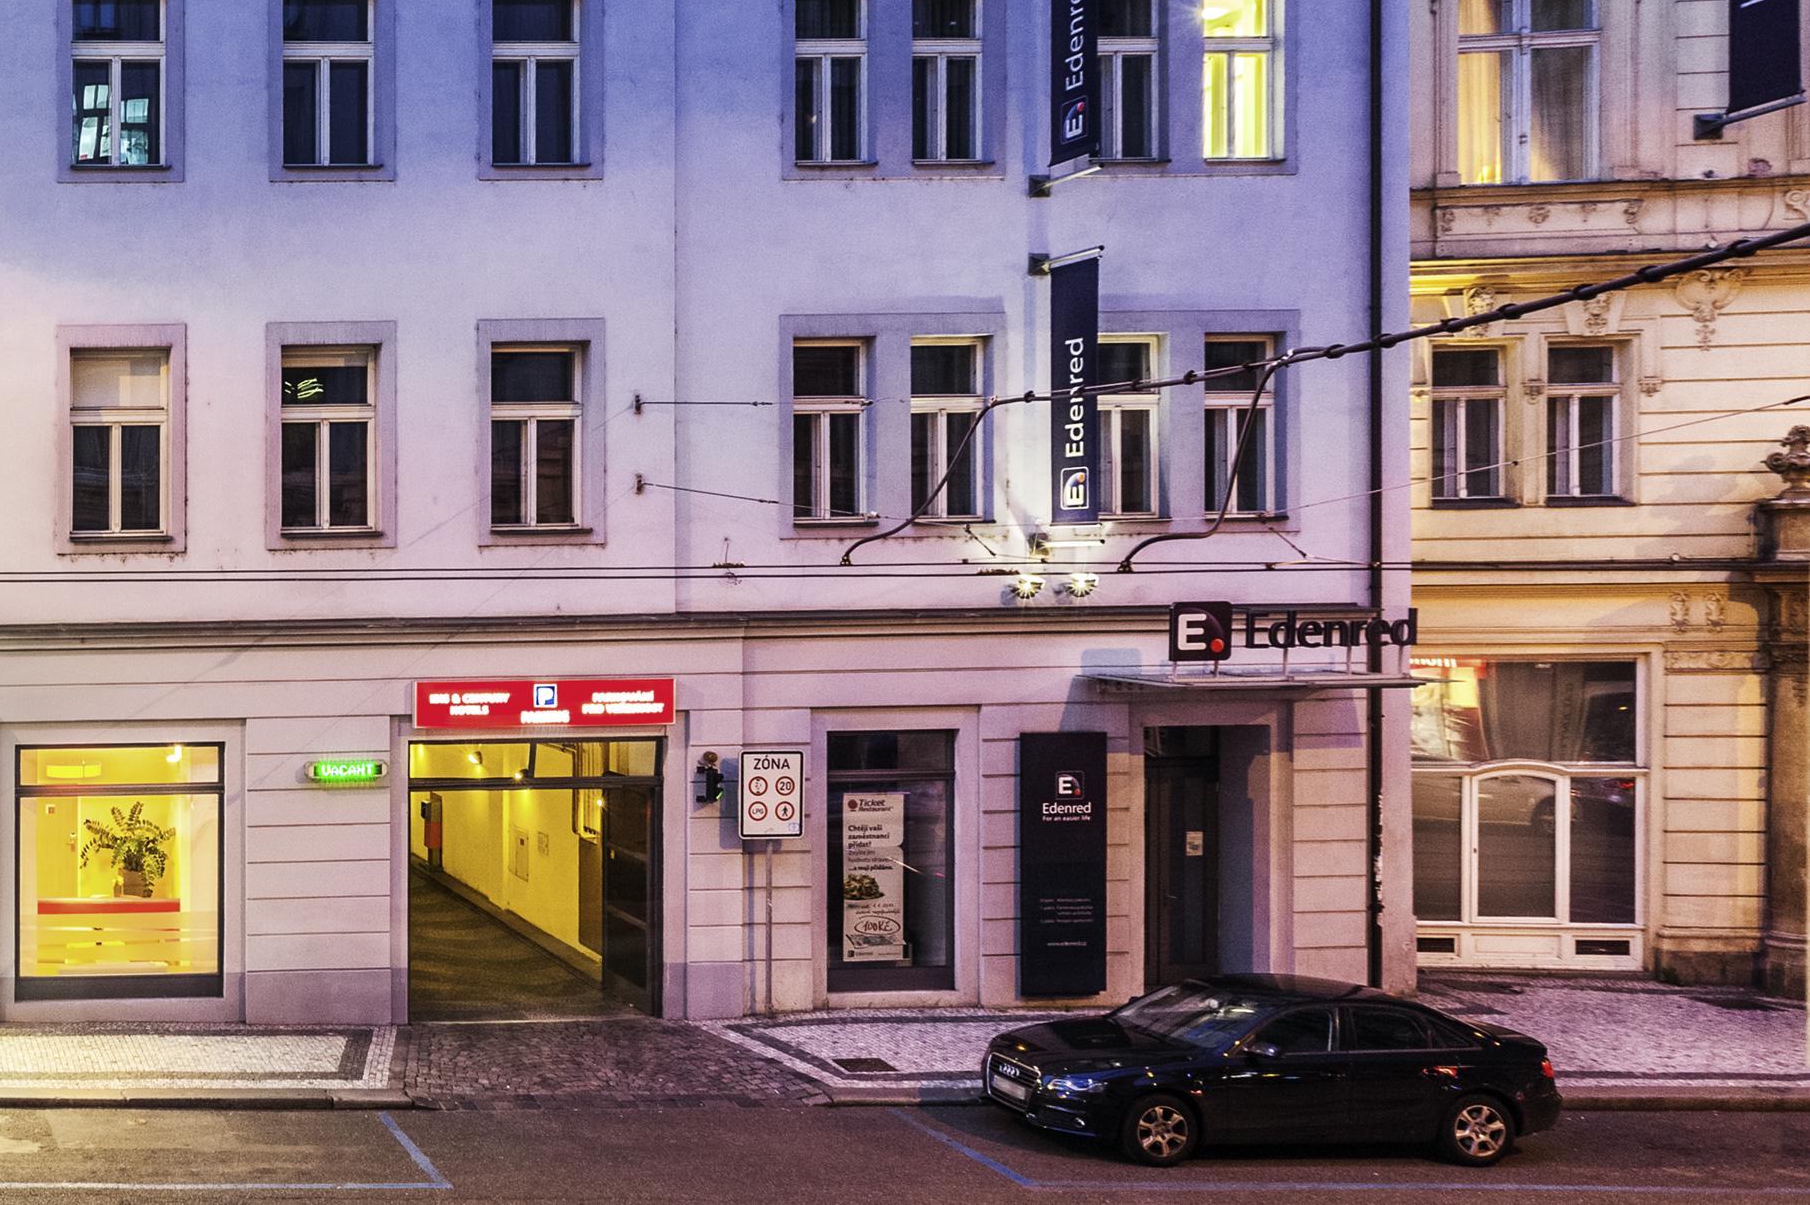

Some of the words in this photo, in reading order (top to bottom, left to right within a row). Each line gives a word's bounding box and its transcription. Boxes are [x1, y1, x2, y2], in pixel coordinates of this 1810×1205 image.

[1065, 337, 1085, 459] Edenred
[1245, 608, 1418, 649] Edenred
[753, 755, 790, 770] ZÓNA
[321, 763, 374, 777] VACANT
[779, 781, 792, 791] 20
[1042, 802, 1091, 814] Edenred
